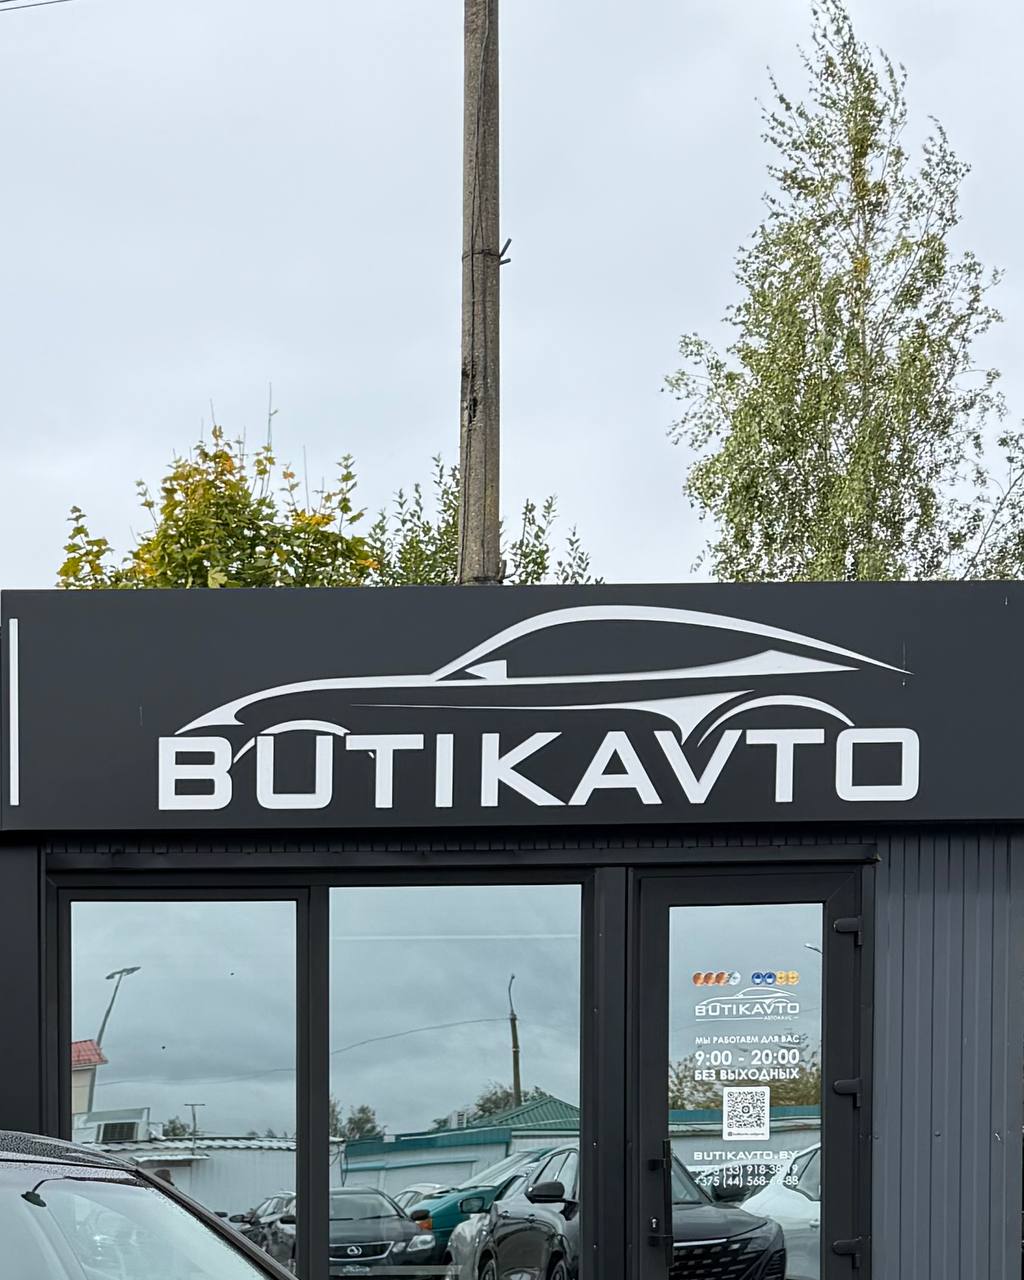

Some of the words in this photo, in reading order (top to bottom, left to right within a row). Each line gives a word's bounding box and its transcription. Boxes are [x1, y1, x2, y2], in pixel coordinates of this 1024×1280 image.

[158, 727, 920, 811] BUTIKAVTO
[695, 1003, 799, 1016] BUTIKAVTO
[695, 1036, 711, 1044] МЫ
[713, 1035, 758, 1044] РАБОТАЕМ
[760, 1035, 779, 1044] ДЛЯ
[781, 1034, 800, 1043] ВАС
[695, 1050, 732, 1066] 9:00
[751, 1049, 800, 1065] 20:00
[694, 1069, 716, 1081] БЕЗ
[719, 1068, 799, 1081] ВЫХОДНЫХ
[693, 1151, 799, 1161] BUTIKAVTO.BY
[723, 1164, 743, 1176] (33)
[723, 1175, 743, 1188] (44)
